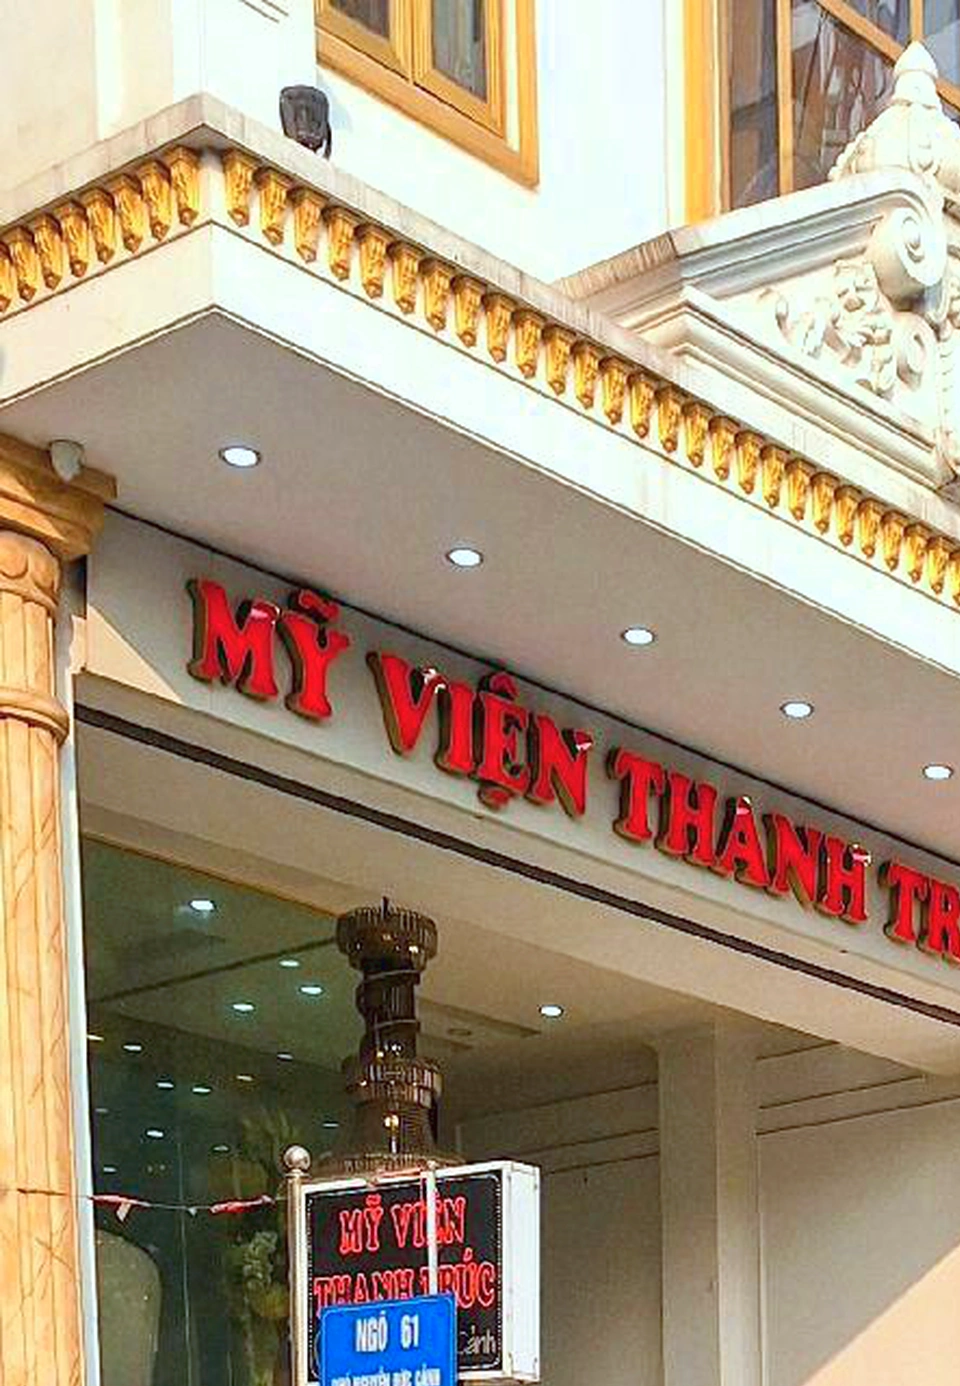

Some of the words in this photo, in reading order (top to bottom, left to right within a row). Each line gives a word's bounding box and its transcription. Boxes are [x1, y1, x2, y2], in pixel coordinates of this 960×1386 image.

[189, 580, 350, 720] MỸ
[366, 651, 594, 818] VIỆN
[339, 1194, 384, 1253] MỸ
[400, 1314, 420, 1350] 61
